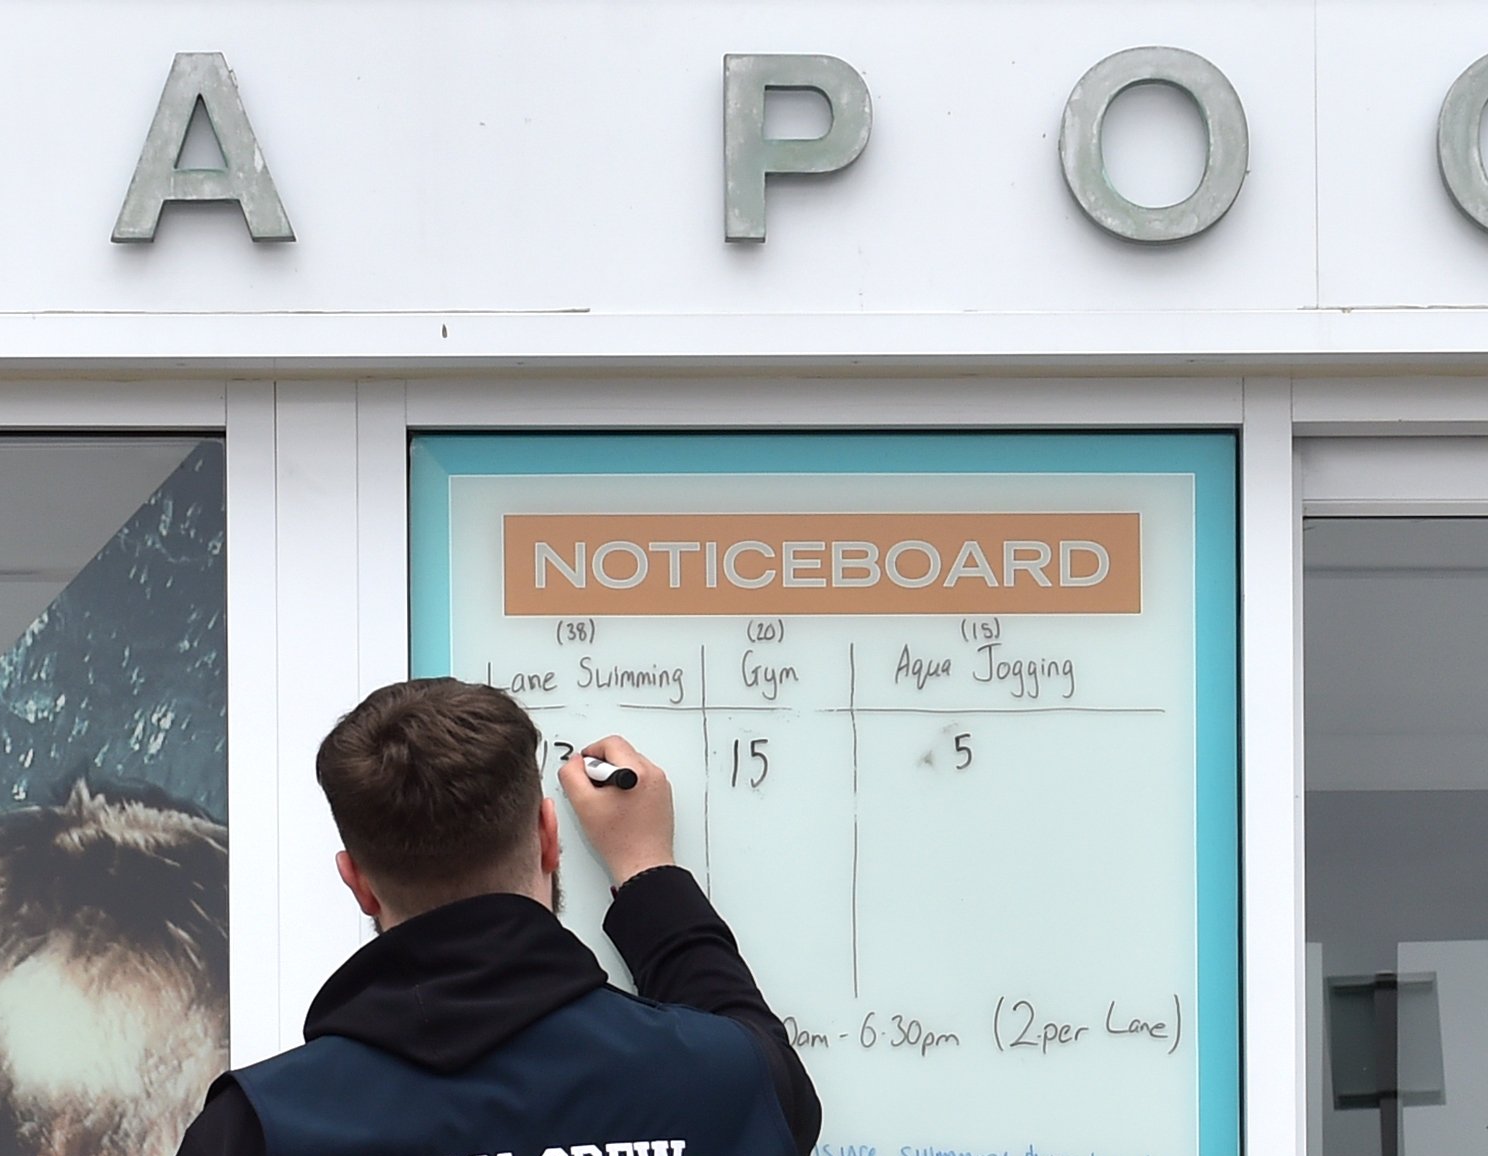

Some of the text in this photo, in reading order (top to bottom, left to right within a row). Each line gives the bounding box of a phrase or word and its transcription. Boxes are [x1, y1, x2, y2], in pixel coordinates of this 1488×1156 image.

[534, 540, 1112, 589] NOTICEBOARD
[556, 618, 596, 645] (38)
[747, 618, 785, 644] (20)
[961, 617, 1000, 642] (15)
[487, 656, 684, 705] Lane Swimming
[741, 649, 799, 701] Gym
[895, 642, 1075, 699] Aqua Jogging
[730, 738, 769, 788] 15
[954, 733, 972, 770] 5
[1106, 993, 1181, 1055] Lane)
